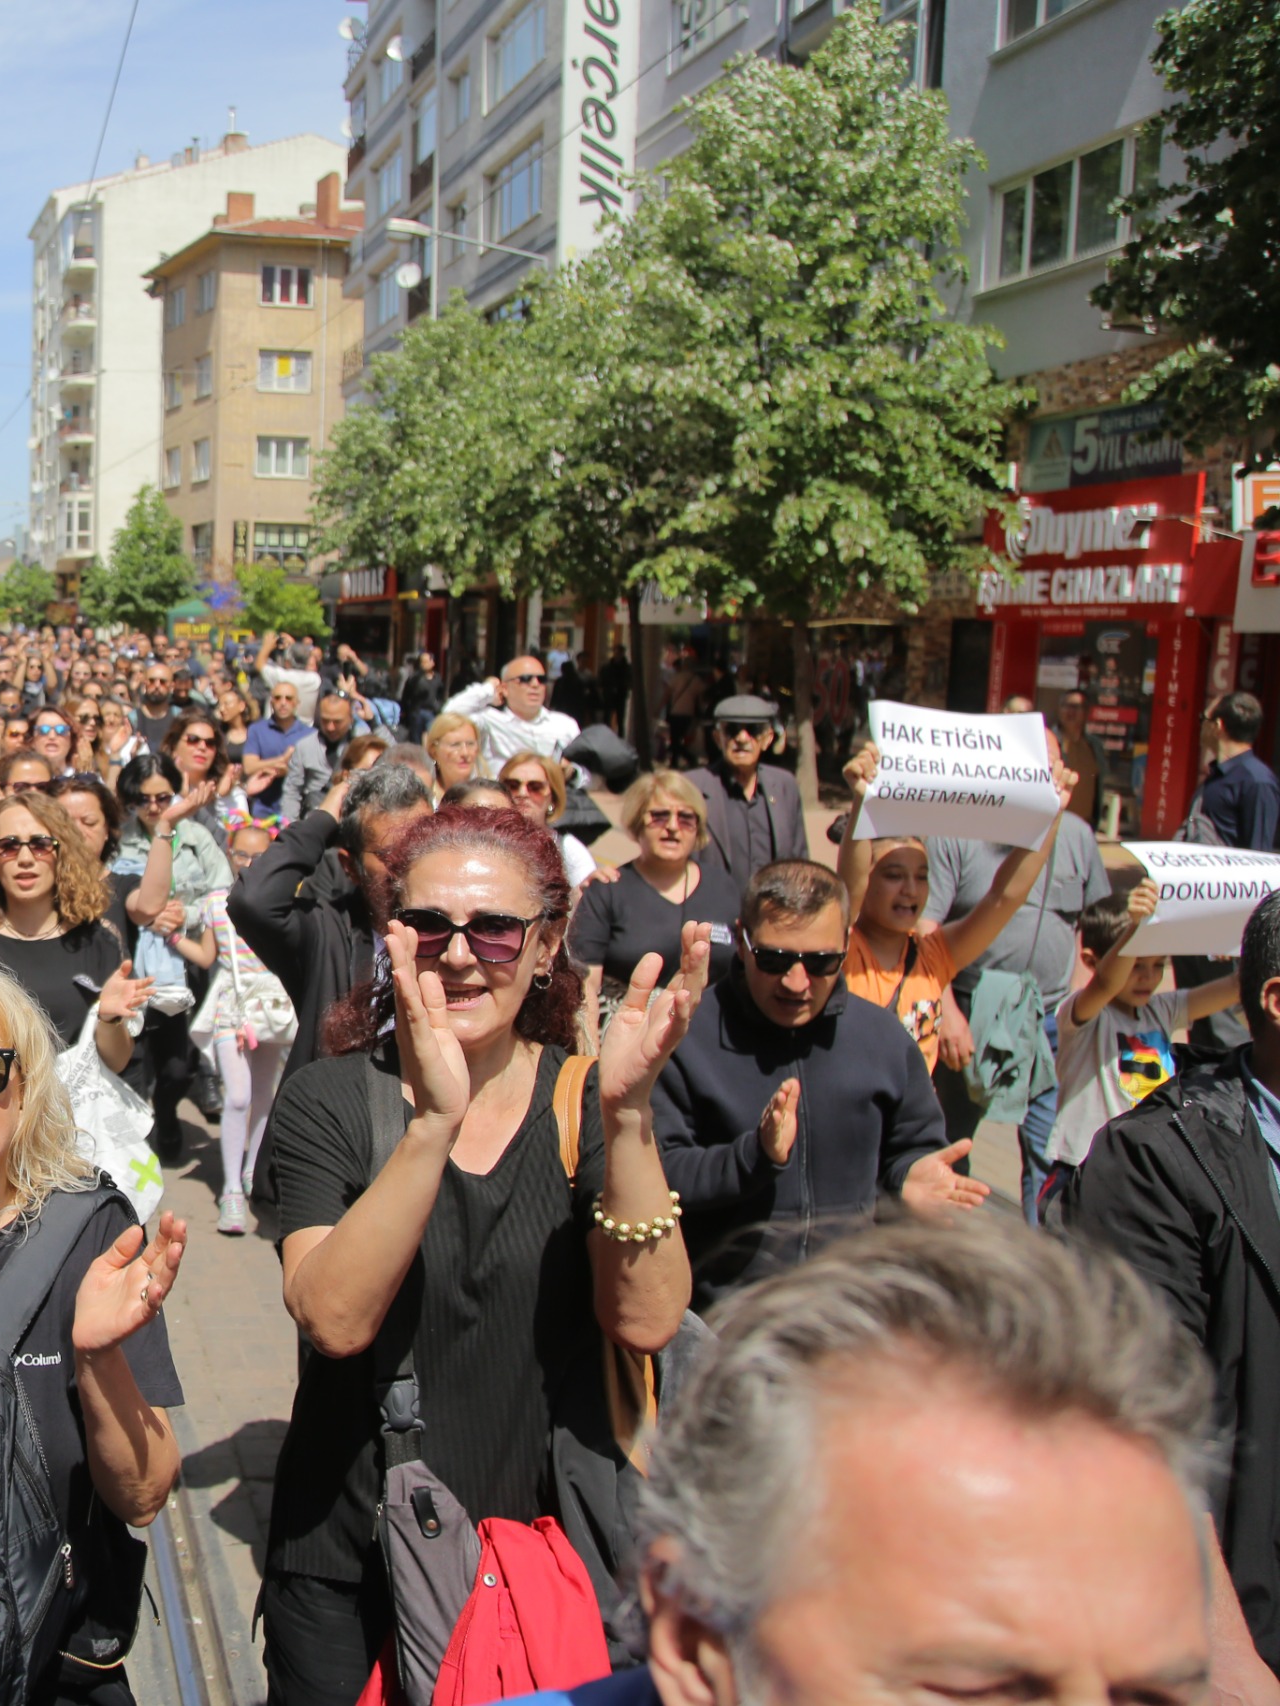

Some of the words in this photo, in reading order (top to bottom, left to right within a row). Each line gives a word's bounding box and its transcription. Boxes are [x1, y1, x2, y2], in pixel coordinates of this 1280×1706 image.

[1072, 415, 1099, 475] 5
[1099, 434, 1125, 472] YIL
[881, 721, 924, 744] HAK
[930, 726, 1003, 751] ETİĞİN
[880, 754, 946, 776] DEĞERİ
[951, 762, 1052, 784] ALACAKSIN
[877, 780, 1006, 808] ÖĞRETMENİM
[1160, 880, 1272, 901] DOKUNMA
